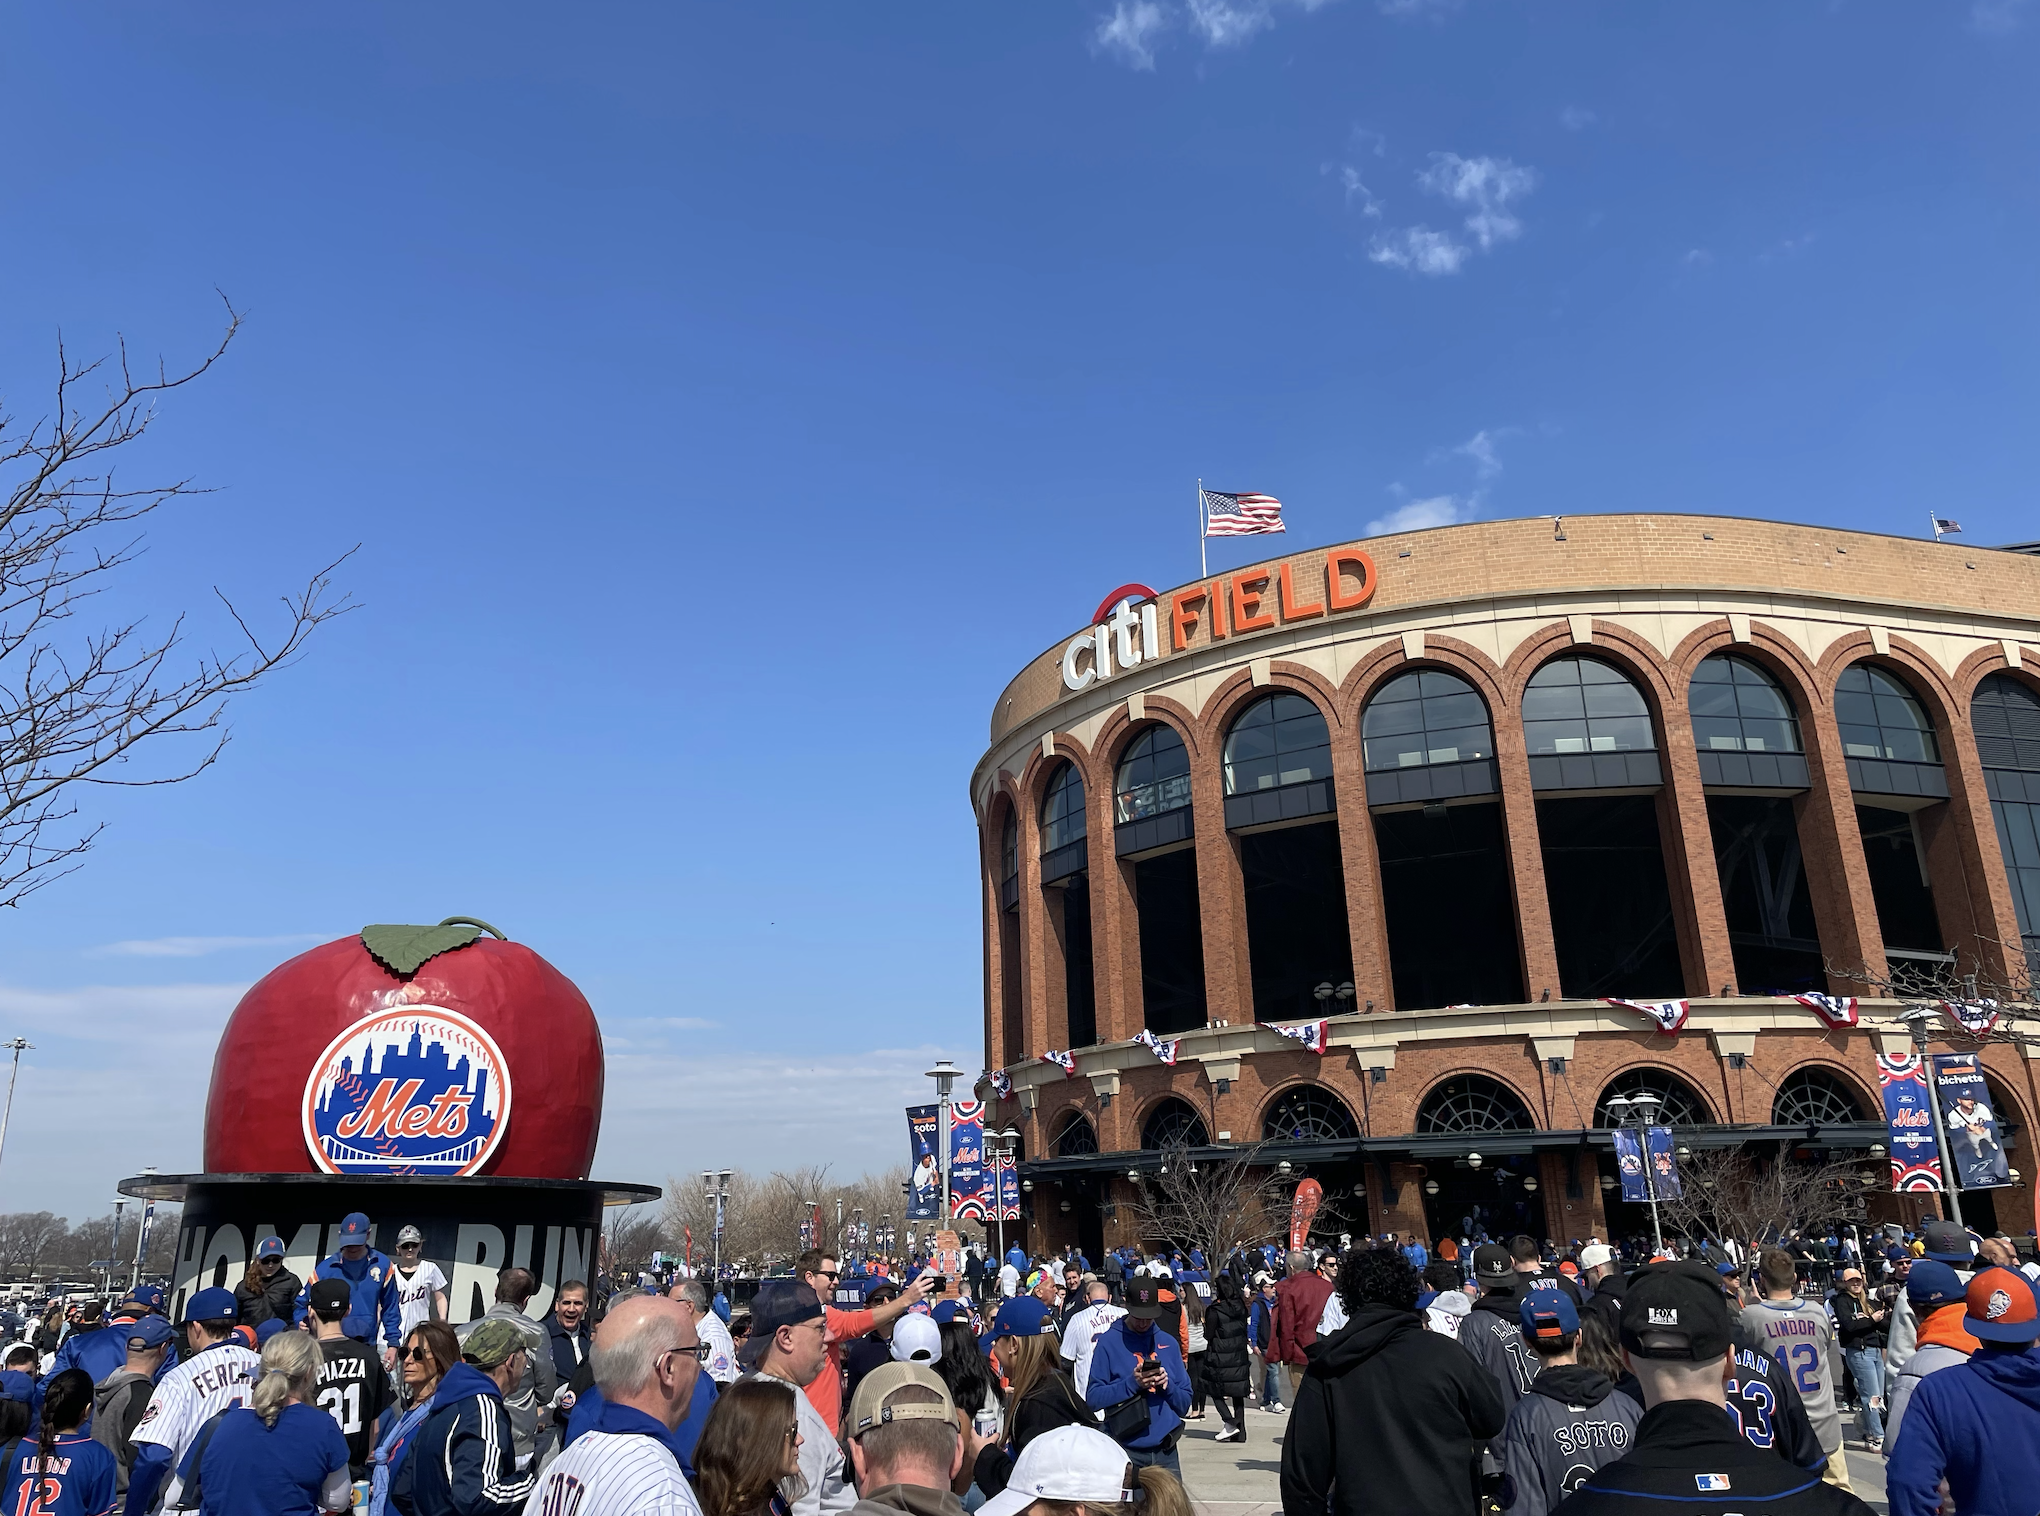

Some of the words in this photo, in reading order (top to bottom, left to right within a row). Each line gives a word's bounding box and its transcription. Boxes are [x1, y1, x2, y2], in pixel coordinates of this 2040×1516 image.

[1062, 599, 1159, 691] citi
[1172, 549, 1378, 650] FIELD
[1938, 1074, 1984, 1085] bichette
[336, 1078, 476, 1138] Mets
[1892, 1108, 1930, 1127] Mets
[914, 1123, 937, 1133] soto
[953, 1147, 980, 1164] Mets
[168, 1223, 378, 1326] HOM
[450, 1223, 592, 1325] RUN
[1654, 1308, 1673, 1318] FOX
[1765, 1319, 1816, 1338] LINDOR
[316, 1358, 366, 1386] PIAZZA
[1773, 1342, 1820, 1393] 12
[316, 1383, 363, 1435] 31
[1553, 1420, 1629, 1456] SOTO
[21, 1456, 72, 1475] LIDOR
[15, 1478, 62, 1516] 12
